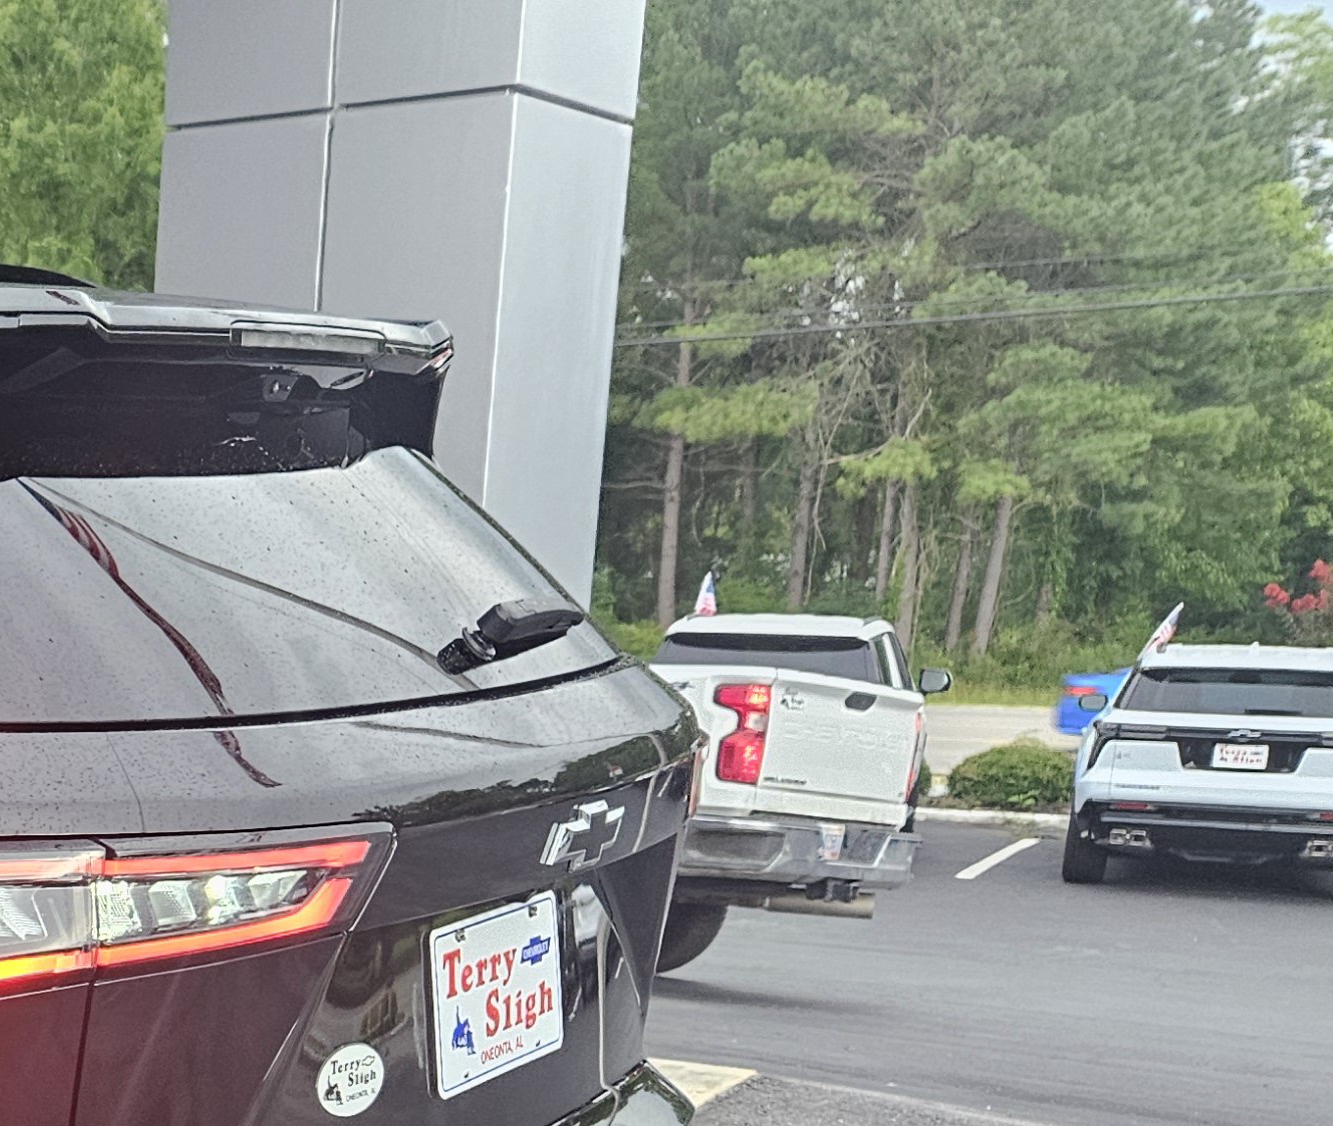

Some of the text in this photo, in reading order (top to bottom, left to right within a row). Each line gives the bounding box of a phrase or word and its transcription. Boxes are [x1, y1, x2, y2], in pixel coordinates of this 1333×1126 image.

[442, 948, 517, 999] Terry
[485, 980, 553, 1038] Sligh
[515, 1035, 524, 1048] AL
[331, 1059, 361, 1075] Terry
[347, 1069, 376, 1087] Sligh
